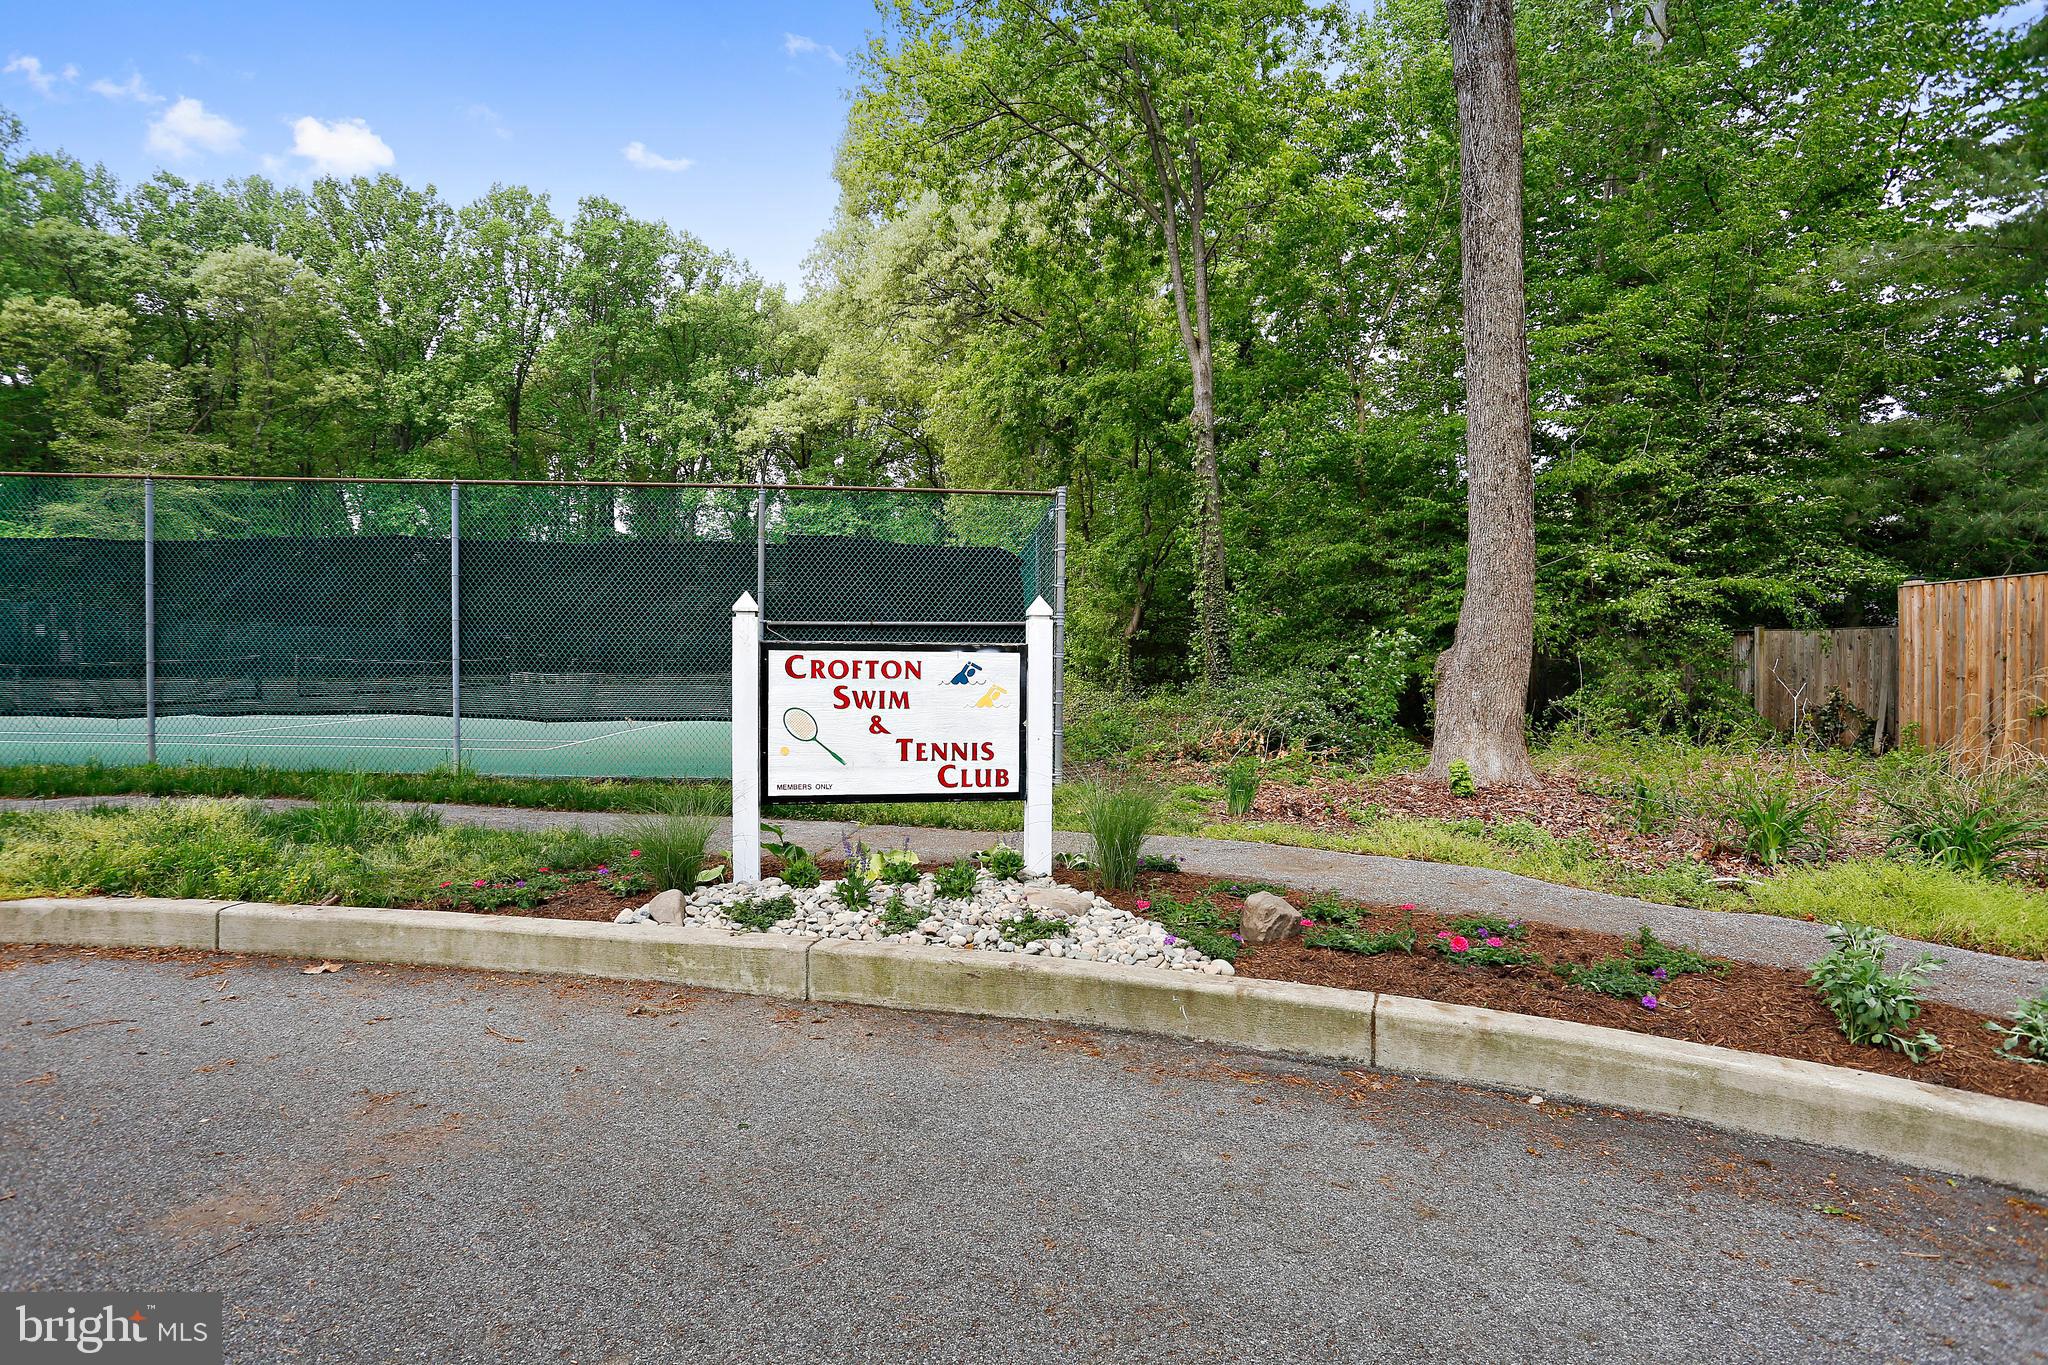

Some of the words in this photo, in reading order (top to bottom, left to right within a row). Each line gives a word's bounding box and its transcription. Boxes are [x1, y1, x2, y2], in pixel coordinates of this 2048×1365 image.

[784, 654, 922, 680] CROFTON
[833, 685, 911, 710] SWIM
[869, 715, 892, 735] &
[895, 738, 995, 762] TENNIS
[776, 783, 812, 791] MEMBERS
[815, 783, 834, 791] ONLY
[937, 764, 1010, 788] CLUB
